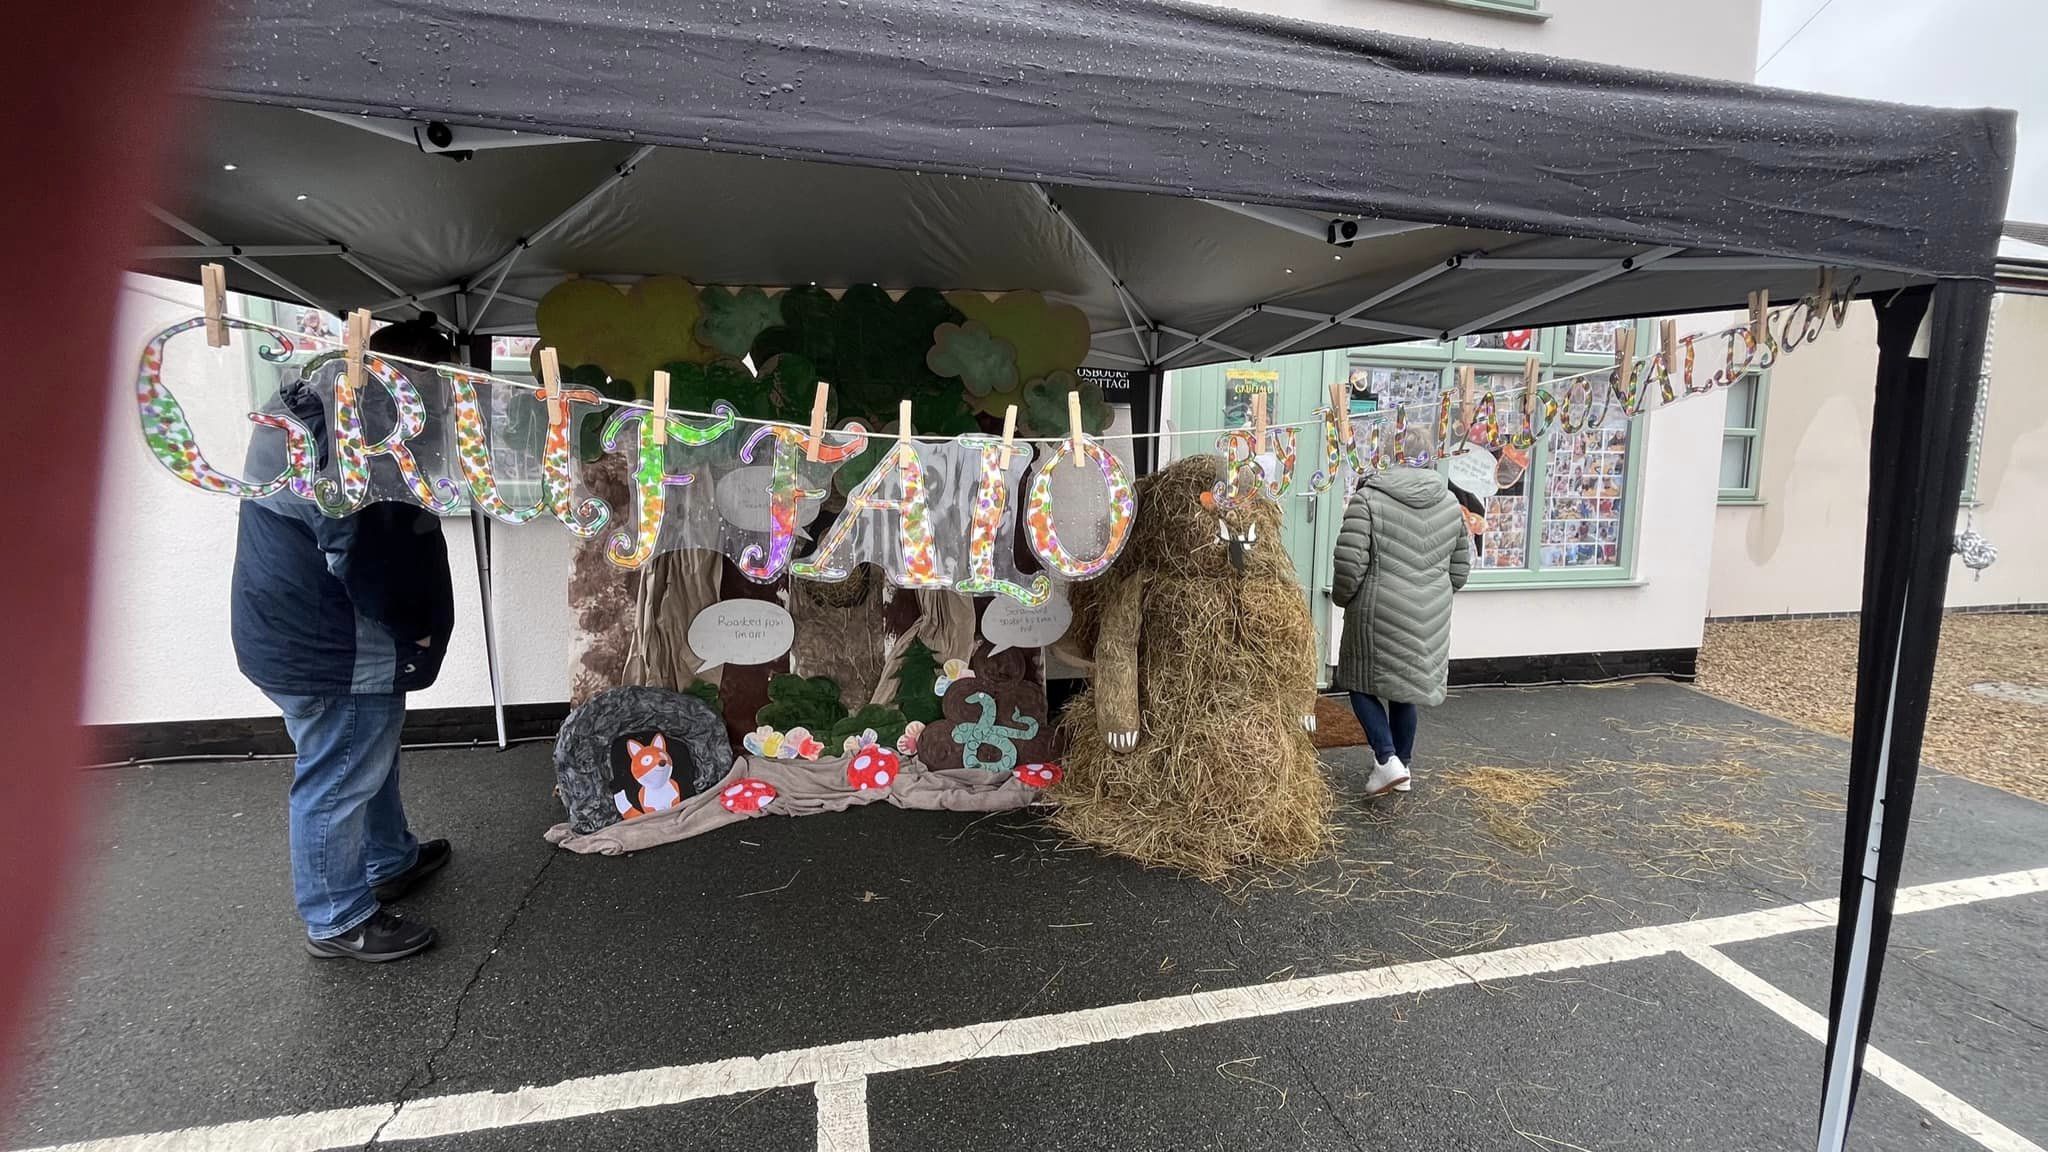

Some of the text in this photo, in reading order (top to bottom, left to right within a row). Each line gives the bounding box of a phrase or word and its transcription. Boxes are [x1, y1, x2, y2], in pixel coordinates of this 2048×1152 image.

[136, 275, 1862, 607] GRUFFALO BY JULIA DONALDSON
